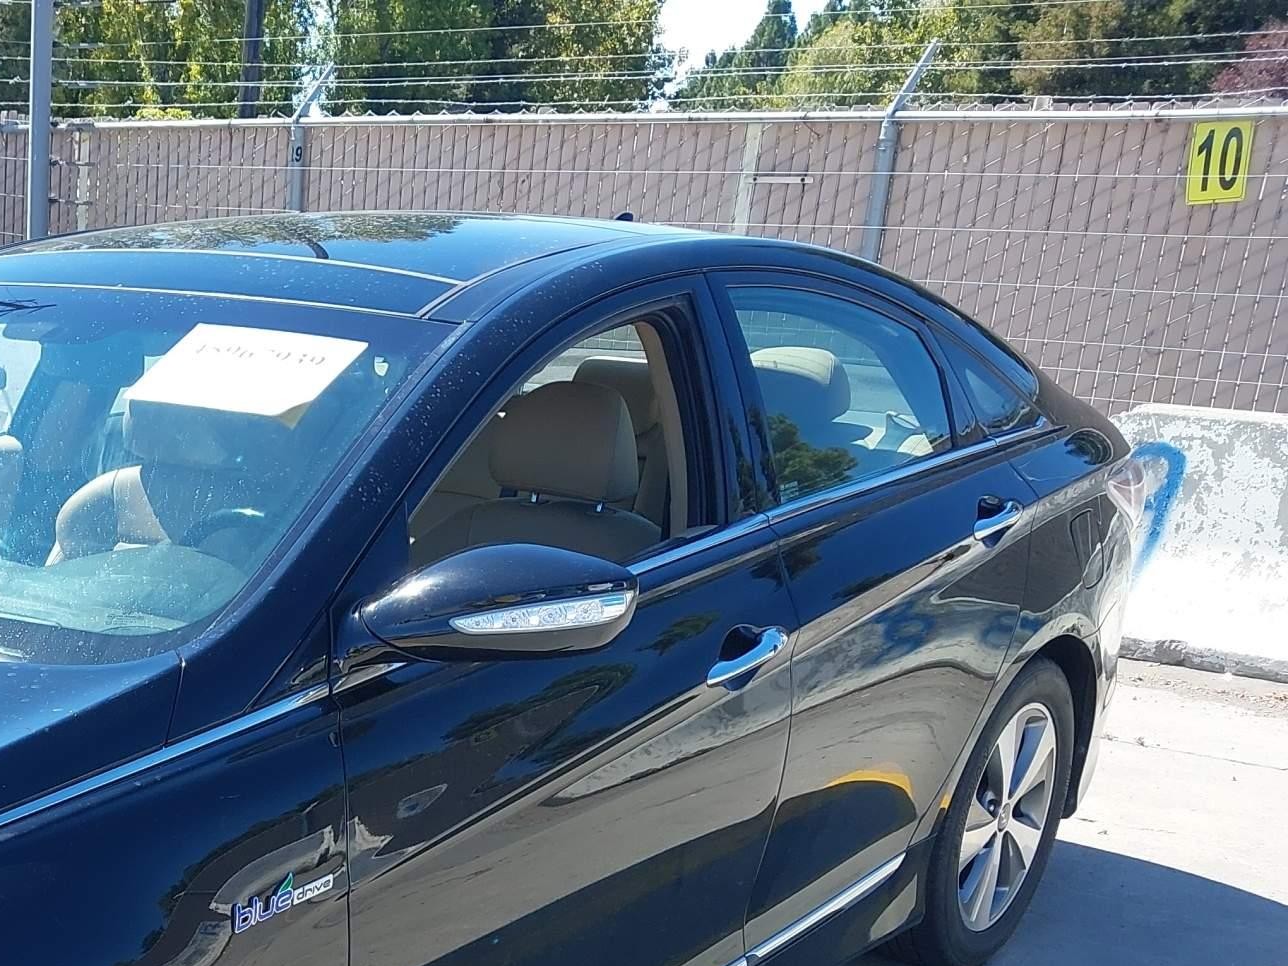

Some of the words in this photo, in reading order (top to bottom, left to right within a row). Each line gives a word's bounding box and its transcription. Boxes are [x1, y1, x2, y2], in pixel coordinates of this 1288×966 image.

[1196, 126, 1244, 192] 10
[233, 886, 294, 934] blue
[296, 878, 332, 901] drive
